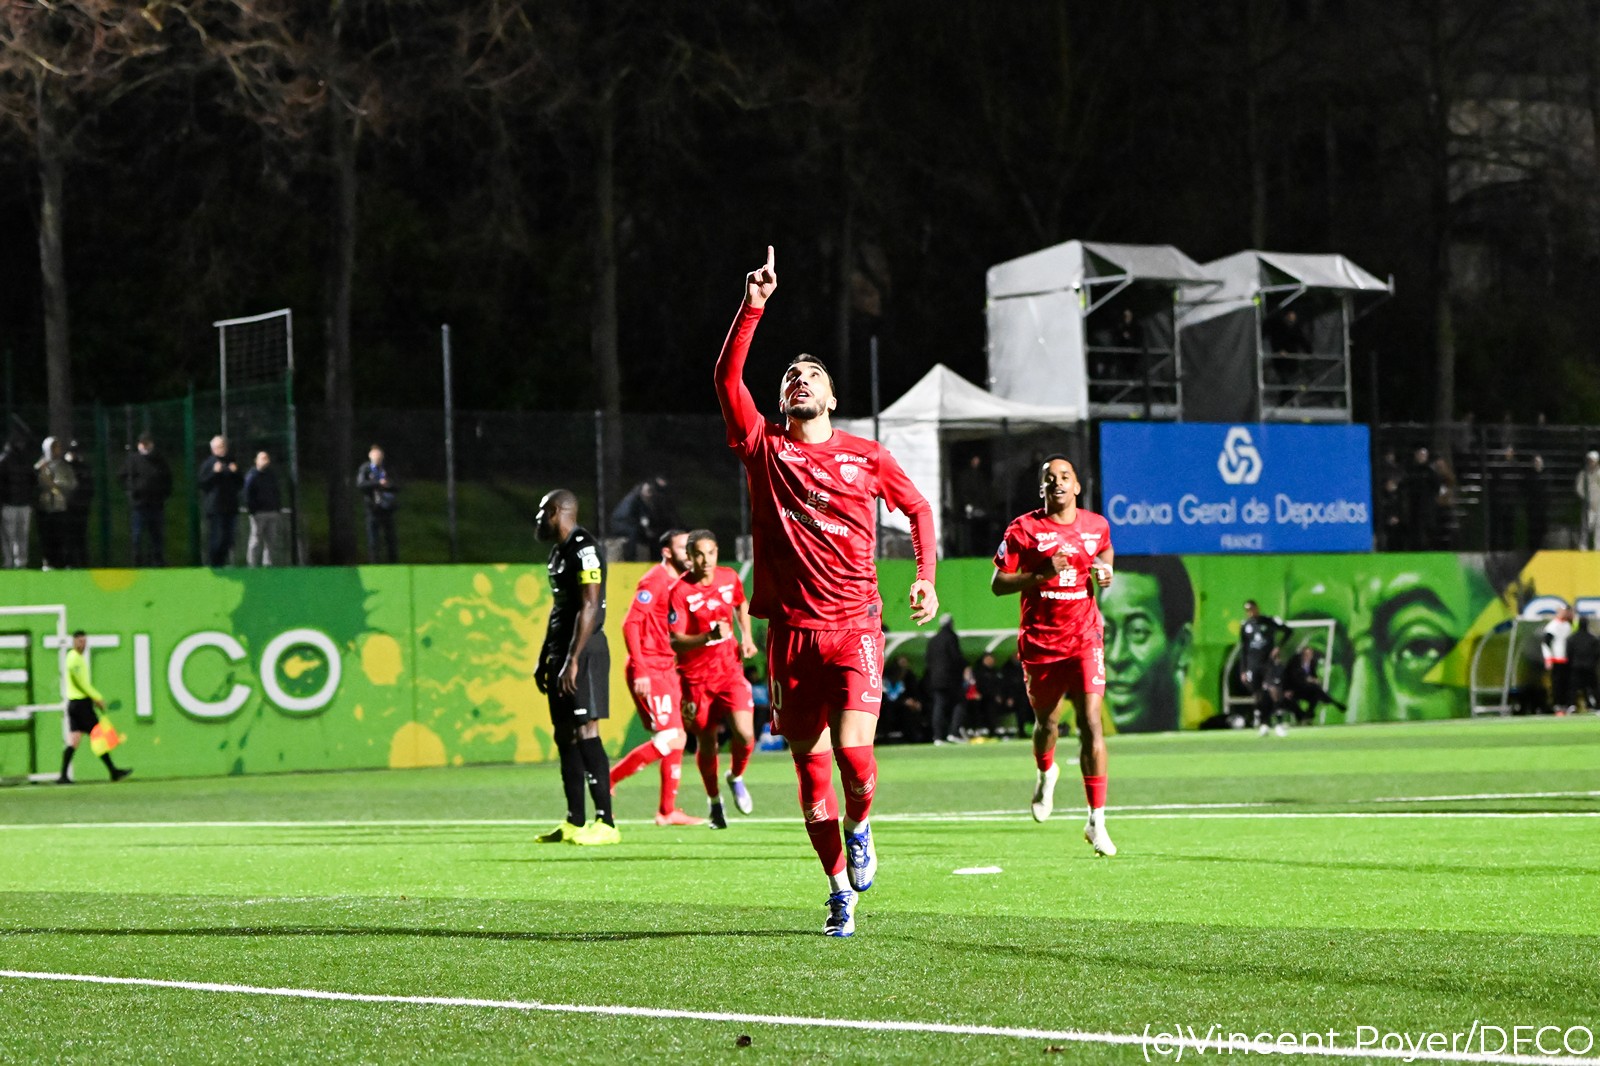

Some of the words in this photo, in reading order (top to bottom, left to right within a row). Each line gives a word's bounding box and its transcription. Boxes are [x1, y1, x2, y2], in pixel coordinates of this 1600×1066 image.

[782, 507, 849, 537] weezevent
[1107, 494, 1174, 525] Caixa
[1178, 494, 1238, 526] Geral
[1242, 494, 1270, 525] de
[1219, 534, 1264, 549] FRANCE
[589, 570, 598, 580] C
[861, 634, 878, 689] CHOPARD
[652, 693, 673, 715] 14
